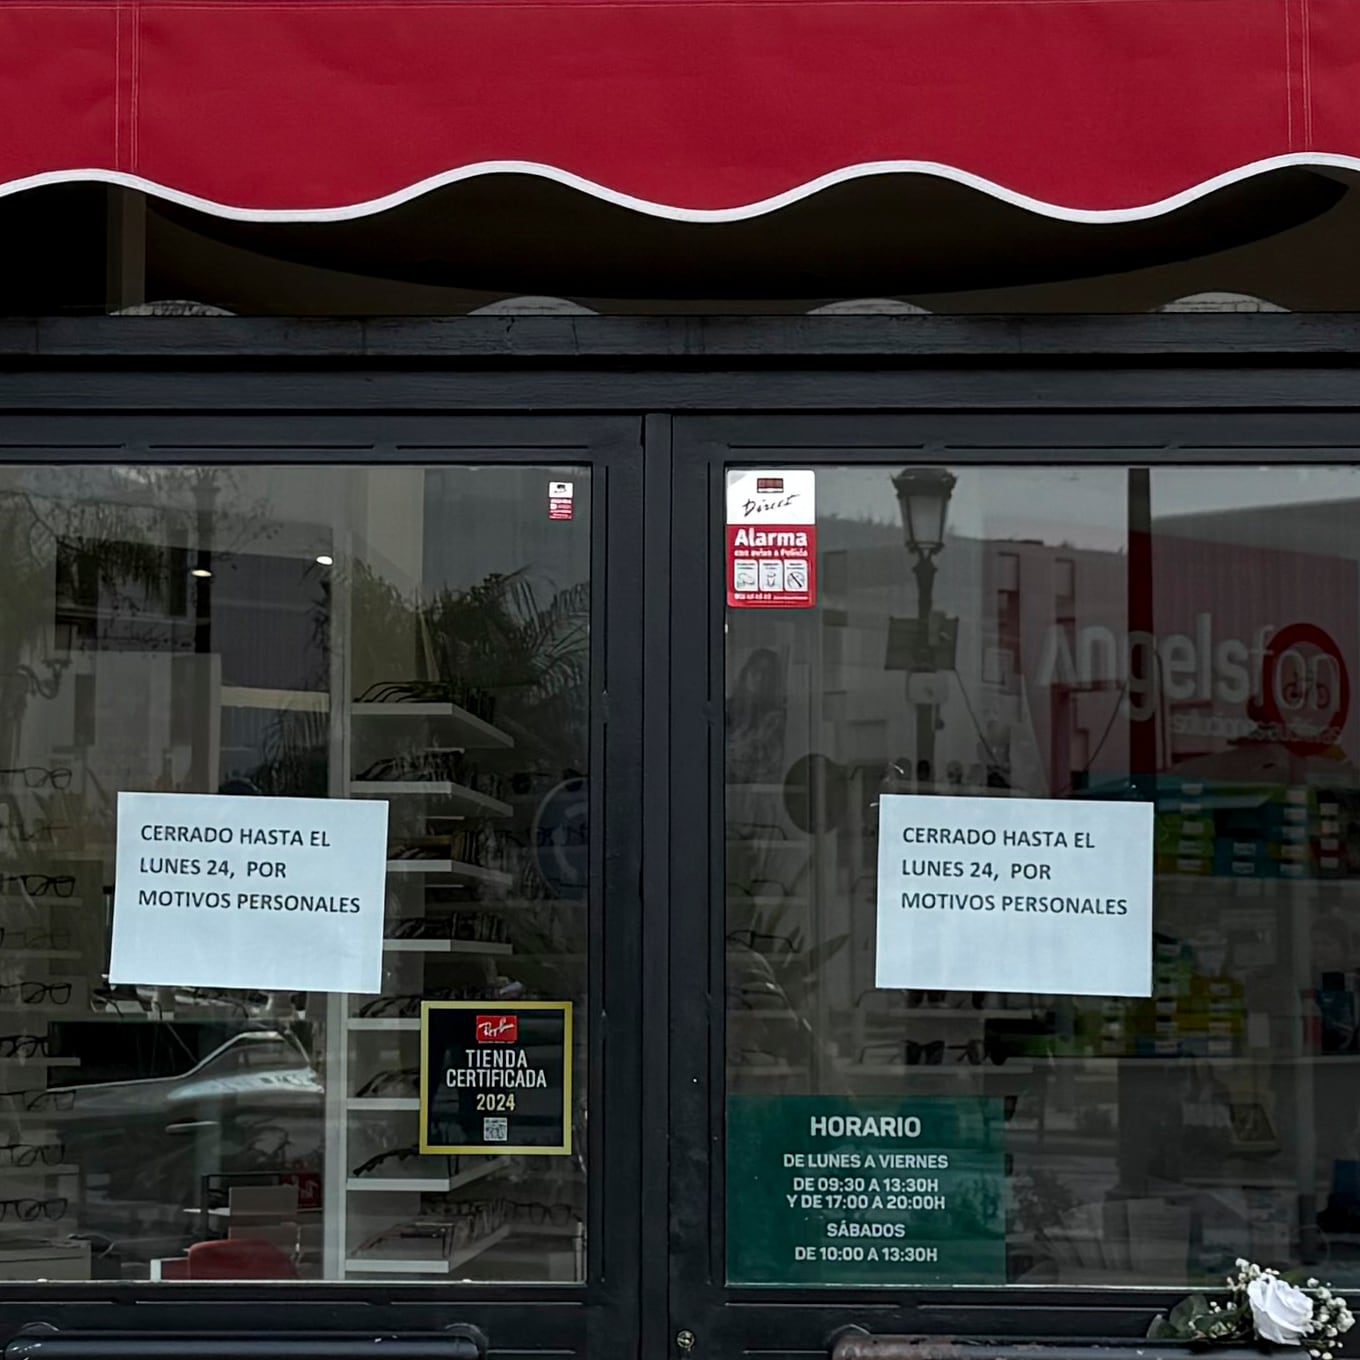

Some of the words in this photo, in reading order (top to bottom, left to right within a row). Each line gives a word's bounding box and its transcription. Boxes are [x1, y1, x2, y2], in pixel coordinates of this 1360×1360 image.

[734, 528, 808, 547] Alarma
[140, 824, 233, 844] CERRADO
[240, 828, 303, 846] HASTA
[310, 830, 331, 847] EL
[903, 827, 997, 846] CERRADO
[1003, 830, 1068, 848] HASTA
[1074, 832, 1096, 849] EL
[140, 857, 201, 875] LUNES
[206, 859, 235, 880] 24,
[246, 861, 287, 879] POR
[902, 859, 964, 877] LUNES
[970, 862, 999, 881] 24,
[1011, 863, 1052, 880] POR
[138, 890, 231, 909] MOTIVOS
[237, 893, 361, 914] PERSONALES
[901, 892, 995, 911] MOTIVOS
[1002, 896, 1128, 915] PERSONALES
[465, 1049, 528, 1068] TIENDA
[446, 1069, 547, 1088] CERTIFICADA
[476, 1093, 516, 1111] 2024
[810, 1116, 922, 1138] HORARIO
[783, 1154, 805, 1168] DE
[808, 1154, 861, 1169] LUNES
[864, 1155, 876, 1168] A
[879, 1154, 949, 1169] VIERNES
[793, 1178, 815, 1192] DE
[818, 1178, 865, 1192] 09:30
[868, 1178, 880, 1192] A
[883, 1178, 939, 1192] 13:30H
[786, 1195, 798, 1208] Y
[801, 1195, 823, 1209] DE
[825, 1195, 868, 1209] 17:00
[871, 1196, 884, 1209] A
[886, 1196, 946, 1210] 20:00H
[826, 1220, 906, 1238] SÁBADOS
[795, 1247, 817, 1261] DE
[819, 1247, 864, 1261] 10:00
[867, 1248, 879, 1261] A
[882, 1248, 938, 1262] 13:30H
